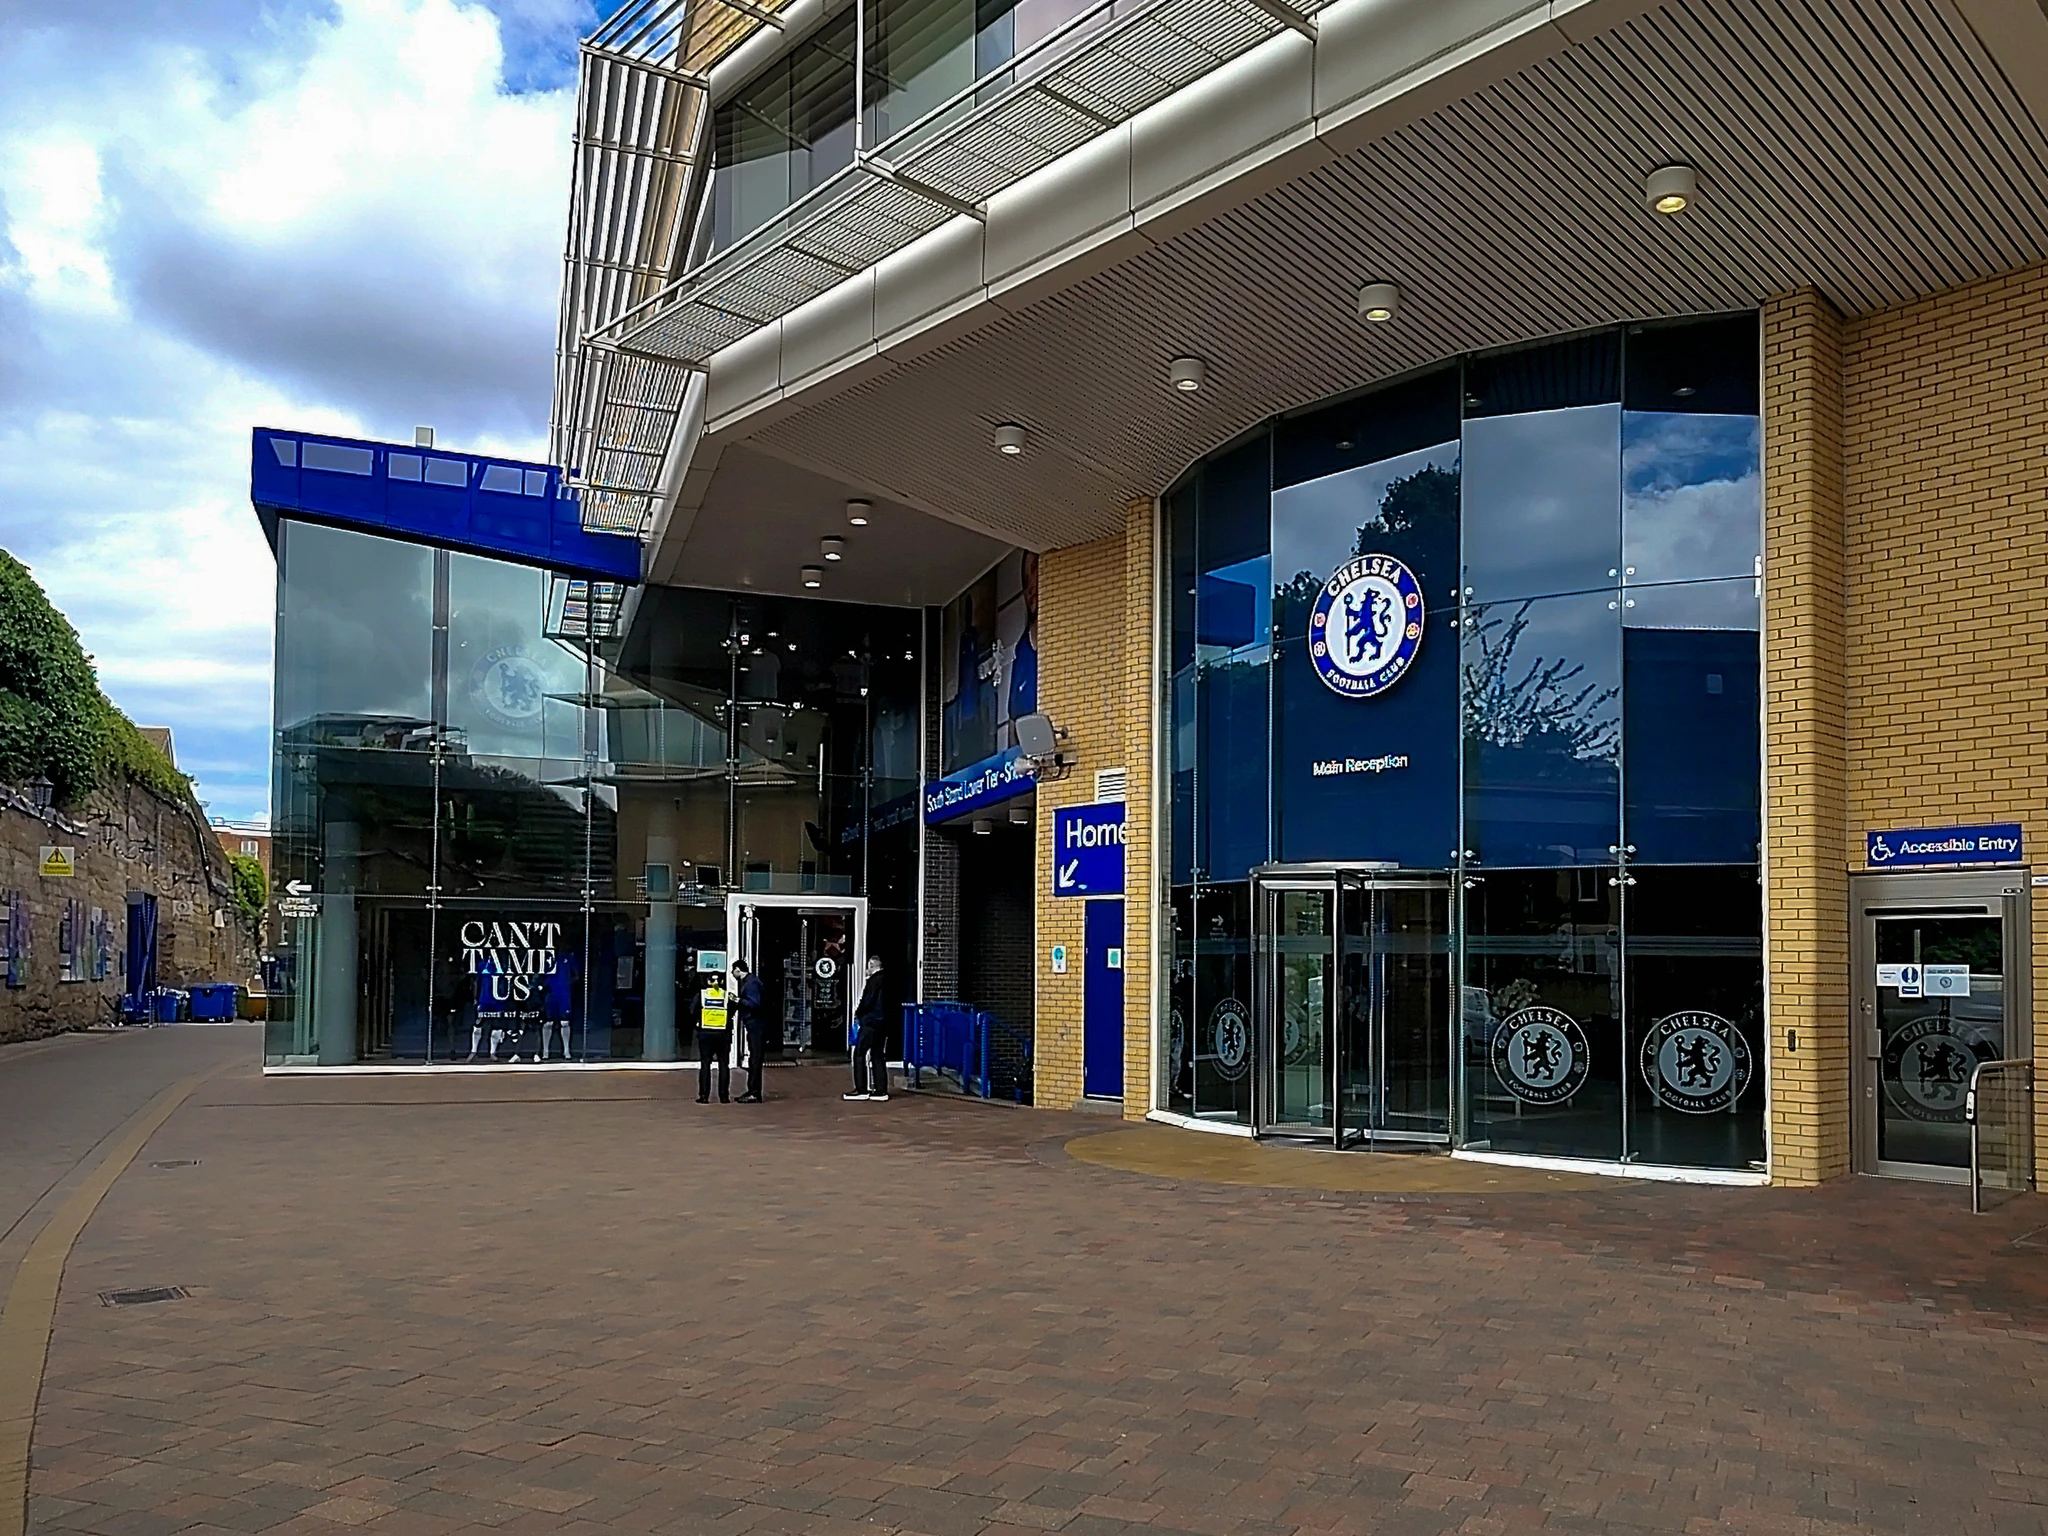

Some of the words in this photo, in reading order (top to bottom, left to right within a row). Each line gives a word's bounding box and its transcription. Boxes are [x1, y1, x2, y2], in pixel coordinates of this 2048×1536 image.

[1327, 557, 1402, 597] CHELSEA
[1312, 760, 1344, 776] Main
[1345, 754, 1408, 773] Reception
[1066, 818, 1129, 849] Home
[1899, 838, 1976, 854] Accessible
[1978, 836, 2018, 853] Entry
[461, 921, 561, 949] CAN'T
[462, 948, 557, 974] TAME
[491, 975, 531, 1001] US
[1509, 1010, 1570, 1032] CHELSEA
[1660, 1015, 1729, 1038] CHELSEA
